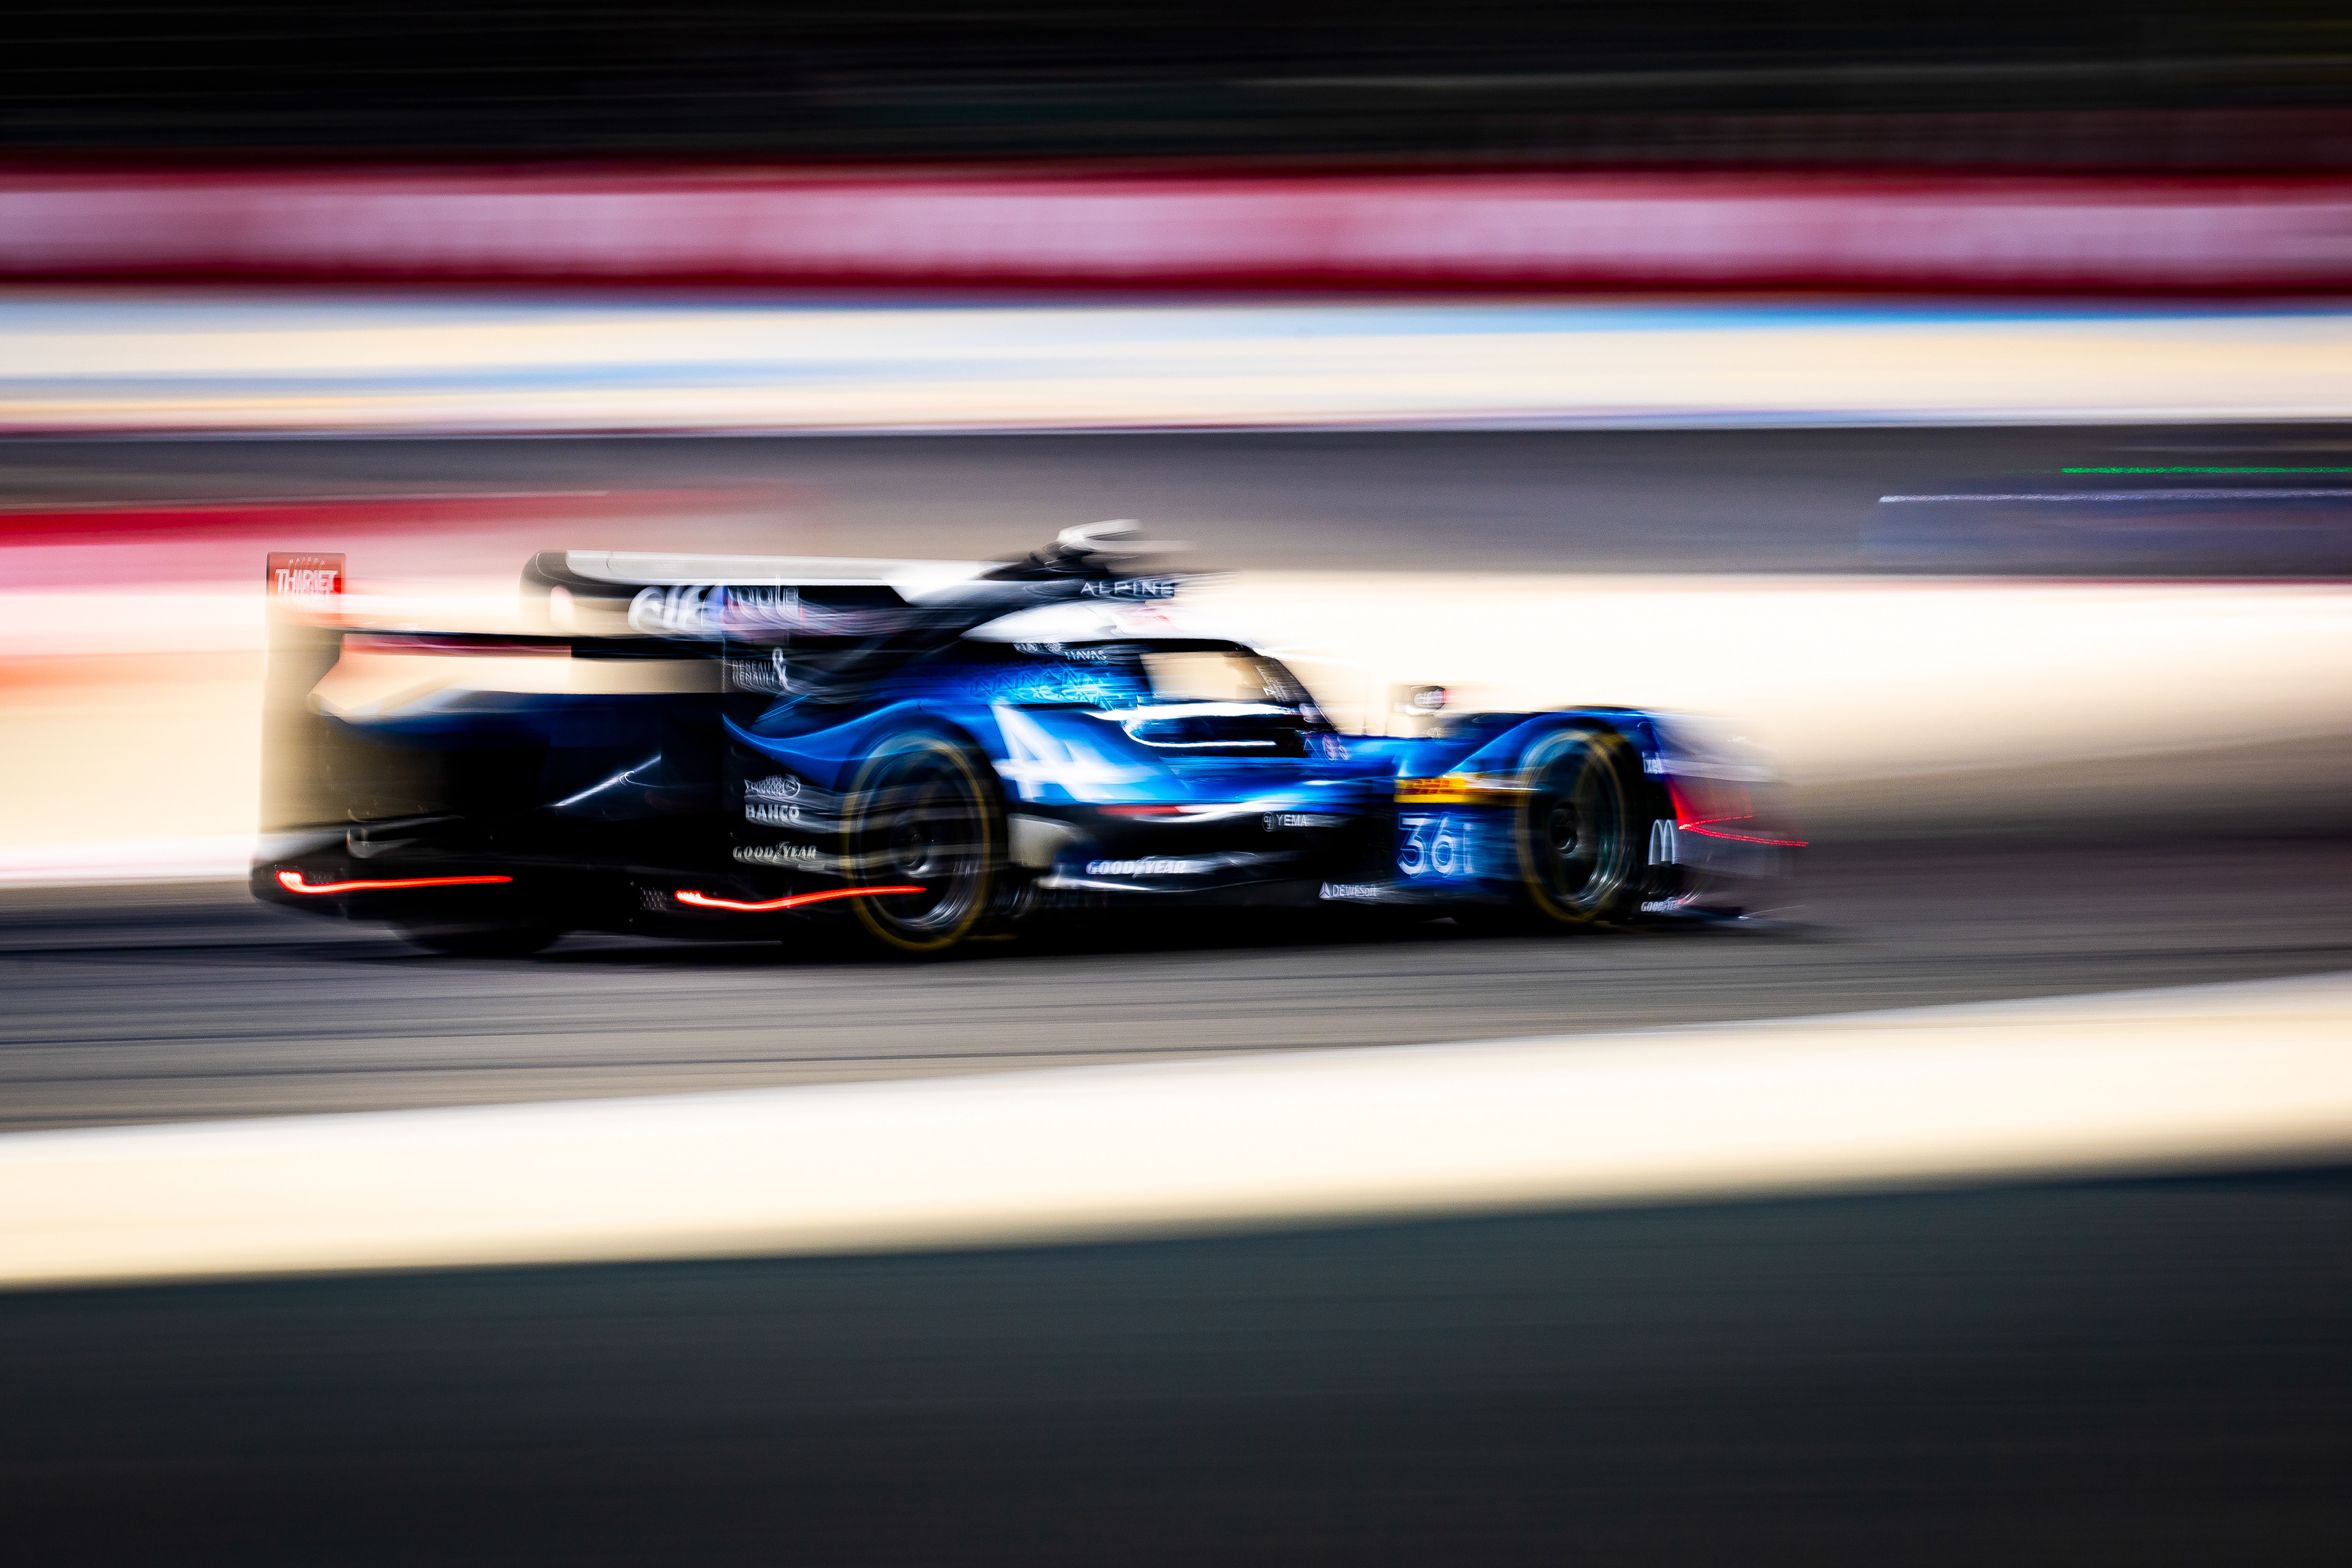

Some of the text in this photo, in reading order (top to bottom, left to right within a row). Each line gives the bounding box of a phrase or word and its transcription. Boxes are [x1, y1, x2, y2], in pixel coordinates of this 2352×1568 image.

[1080, 581, 1175, 597] ALPINE
[1063, 649, 1107, 661] HAVAS
[745, 804, 799, 822] BAHCO
[1276, 814, 1307, 826] YEMA
